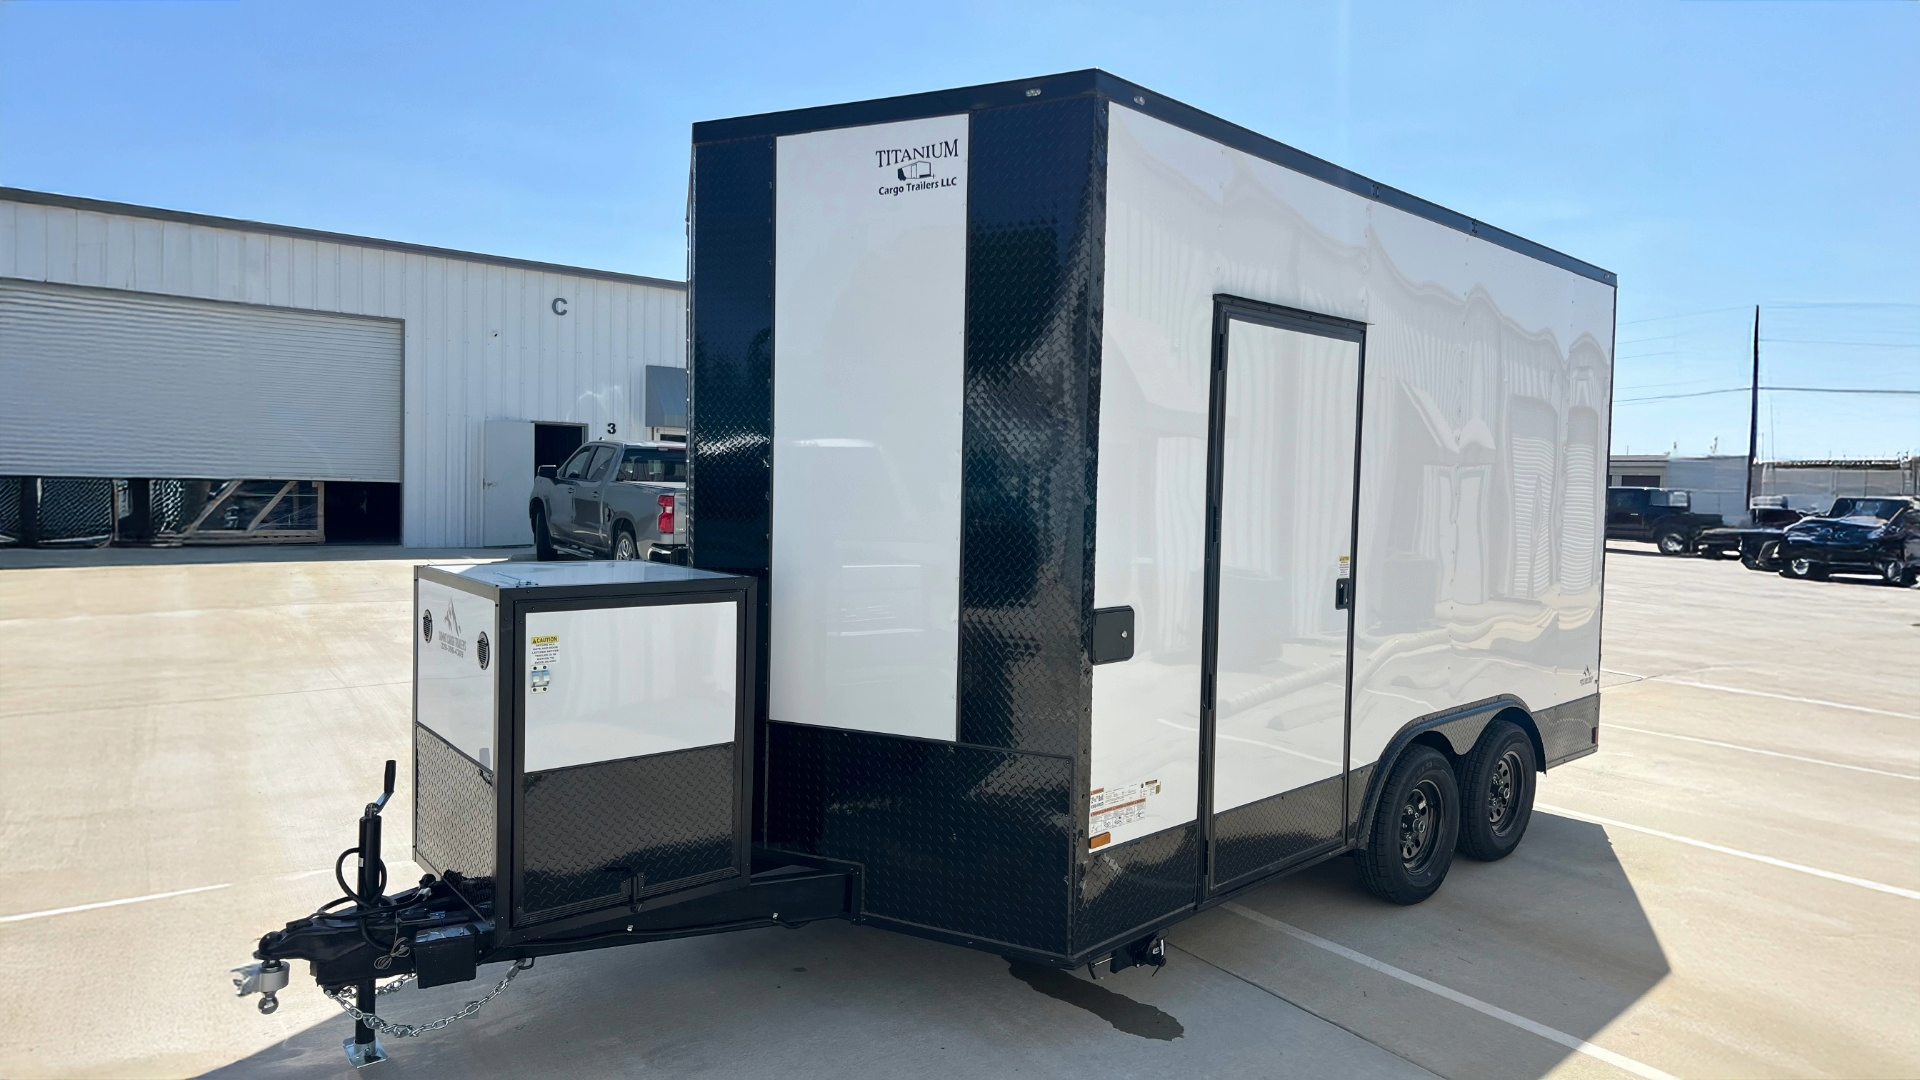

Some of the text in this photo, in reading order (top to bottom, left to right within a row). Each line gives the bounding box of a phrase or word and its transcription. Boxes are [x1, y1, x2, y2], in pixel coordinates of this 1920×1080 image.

[875, 138, 959, 168] TITANIUM
[878, 176, 957, 197] Cargo Trailers LLC
[551, 297, 568, 316] C
[607, 422, 617, 435] 3
